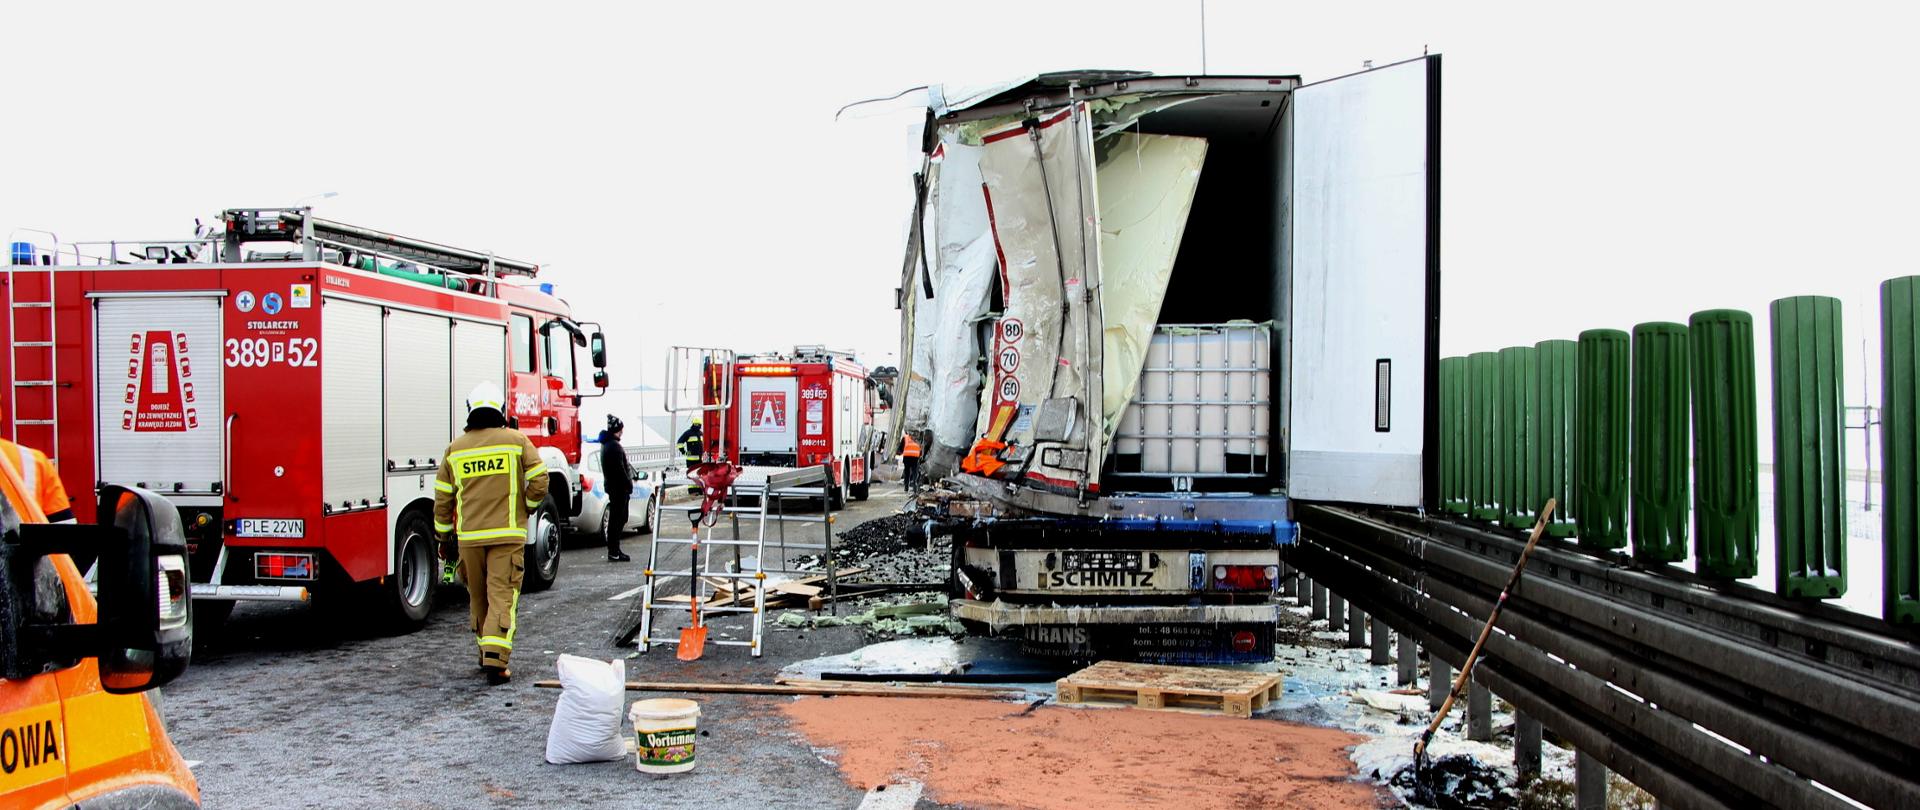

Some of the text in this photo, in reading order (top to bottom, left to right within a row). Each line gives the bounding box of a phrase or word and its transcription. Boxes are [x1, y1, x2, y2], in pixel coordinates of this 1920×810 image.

[247, 321, 299, 329] STOLARCZYK
[1005, 323, 1020, 337] 80
[225, 338, 318, 367] 389 P 52
[1003, 354, 1016, 367] 70
[1003, 382, 1017, 396] 60
[243, 520, 302, 533] PLE 22VN
[1051, 571, 1154, 587] SCHMITZ
[0, 720, 59, 774] OWA
